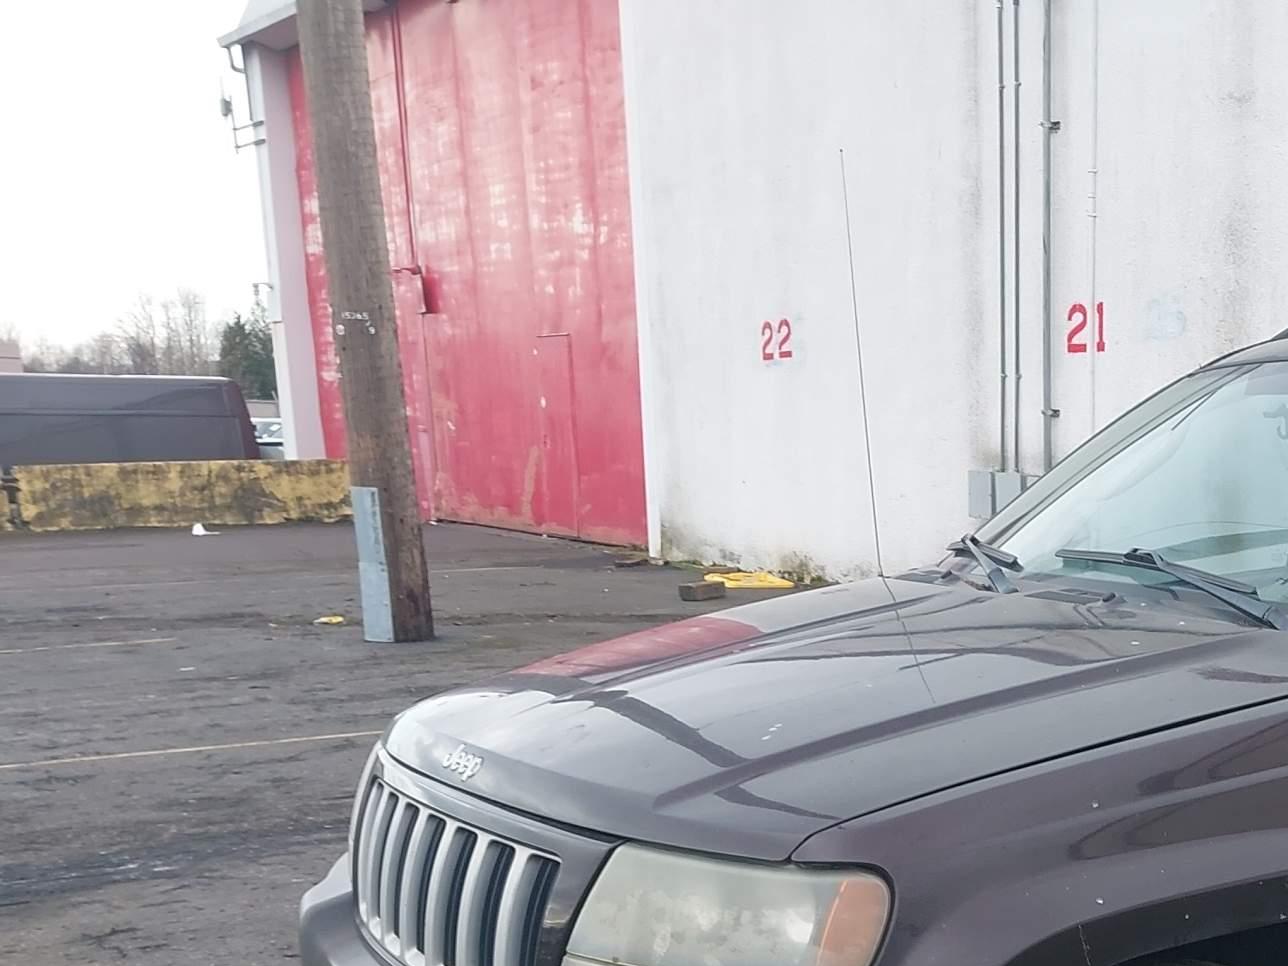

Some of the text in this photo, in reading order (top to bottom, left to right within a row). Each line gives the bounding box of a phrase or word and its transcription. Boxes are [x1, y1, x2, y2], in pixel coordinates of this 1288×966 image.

[761, 318, 793, 361] 22
[1066, 302, 1106, 352] 21
[442, 743, 484, 782] Jeep
